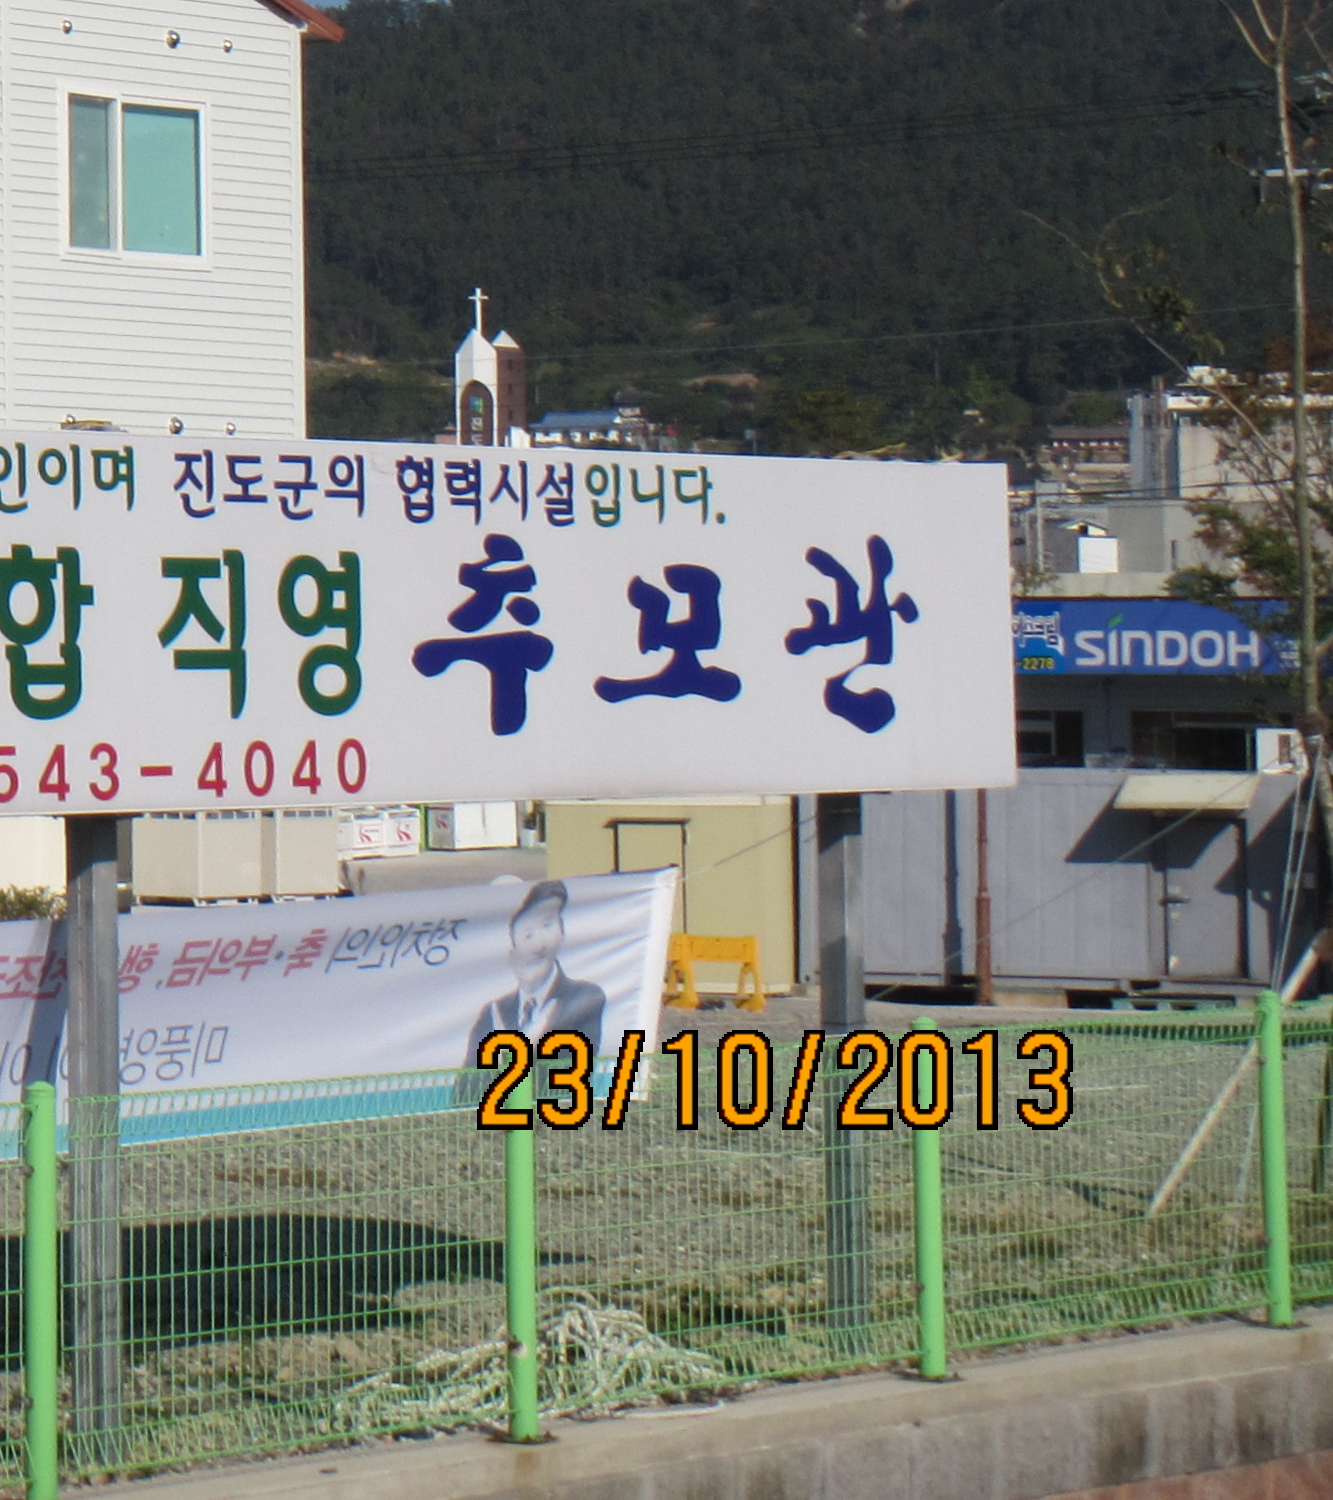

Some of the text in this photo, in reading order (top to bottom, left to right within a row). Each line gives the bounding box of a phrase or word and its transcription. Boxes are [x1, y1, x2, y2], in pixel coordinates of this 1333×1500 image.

[172, 448, 366, 521] 진도군의
[395, 453, 727, 528] 협력시설입니다.
[157, 548, 365, 720] 직영
[412, 533, 920, 736] 추모관
[1075, 616, 1260, 667] SINDOH
